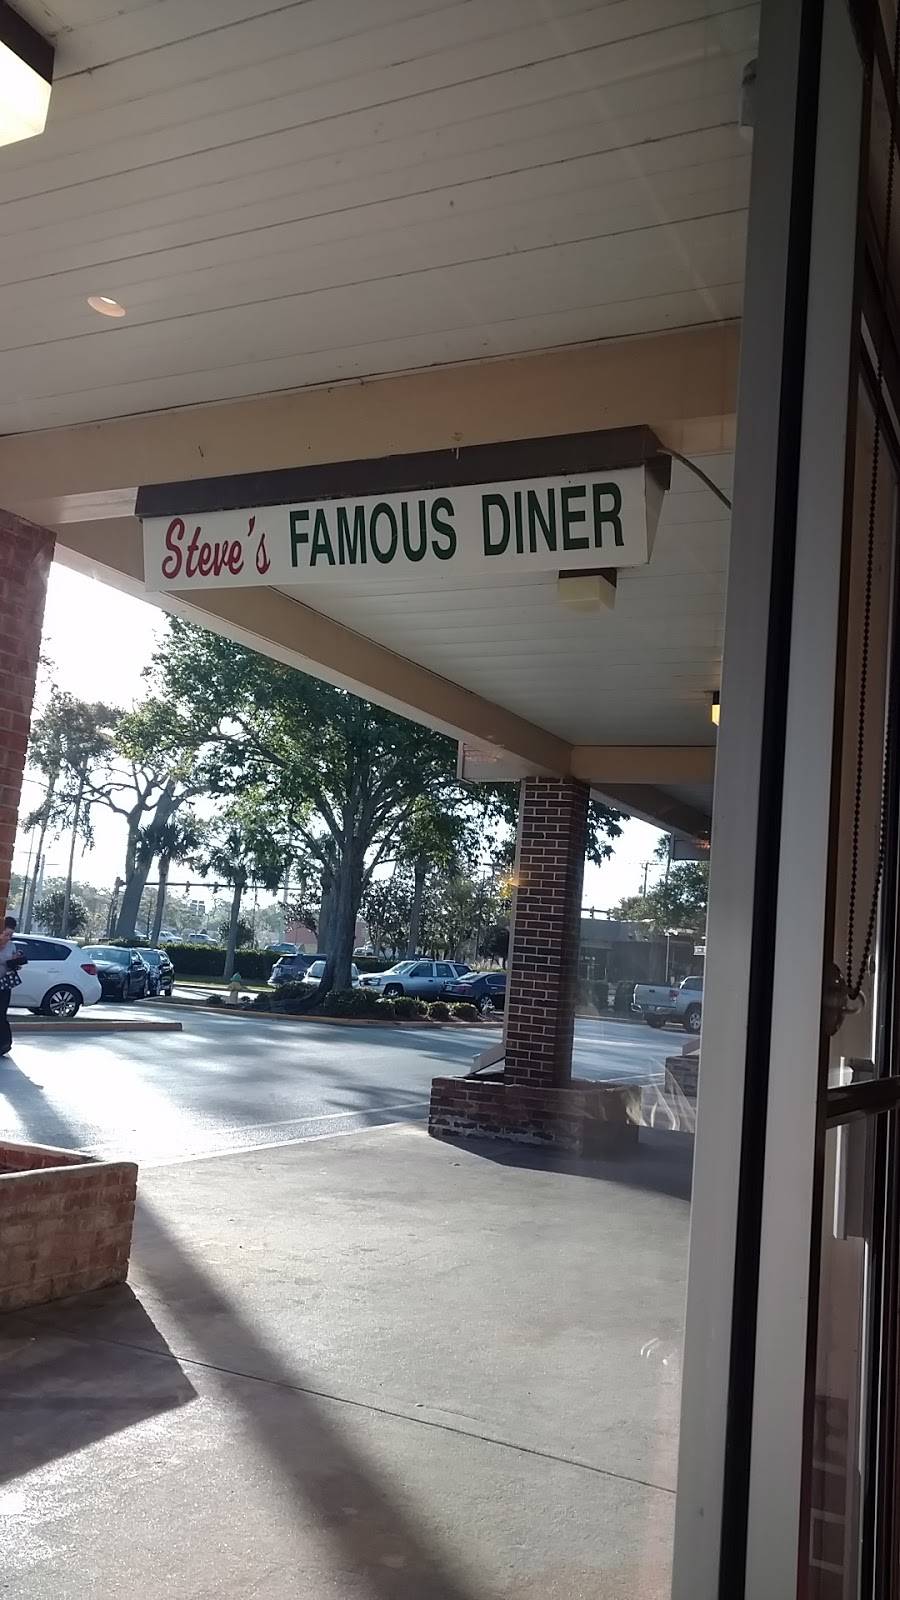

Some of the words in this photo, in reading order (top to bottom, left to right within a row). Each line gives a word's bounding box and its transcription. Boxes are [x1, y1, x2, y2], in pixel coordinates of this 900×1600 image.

[162, 516, 271, 579] Steve's
[289, 497, 457, 567] FAMOUS
[482, 481, 625, 556] DINER
